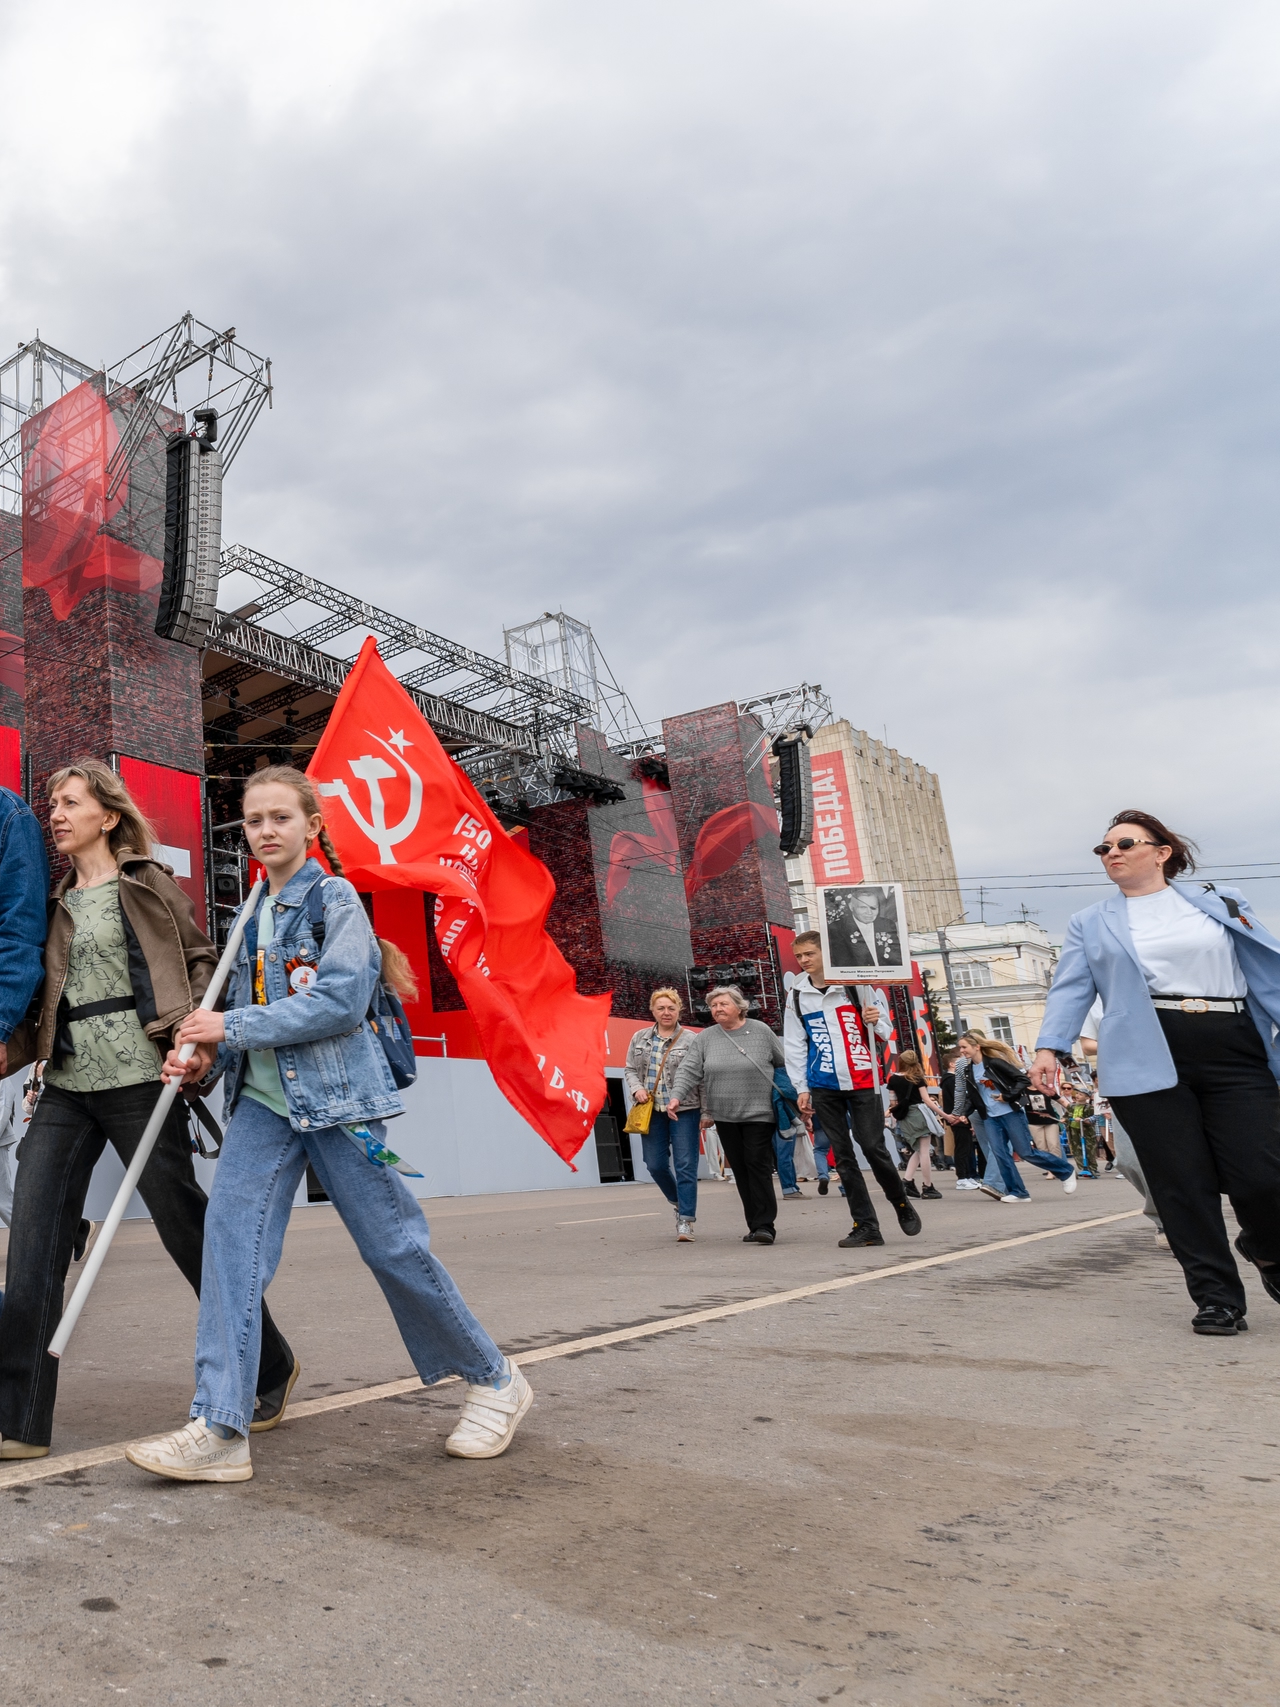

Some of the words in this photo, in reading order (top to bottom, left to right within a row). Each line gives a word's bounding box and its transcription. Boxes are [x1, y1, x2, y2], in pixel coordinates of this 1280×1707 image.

[452, 812, 493, 850] 150
[811, 767, 851, 878] ПОБЕДА!
[807, 1016, 835, 1074] RUSSIA
[840, 1011, 873, 1071] RUSSIA
